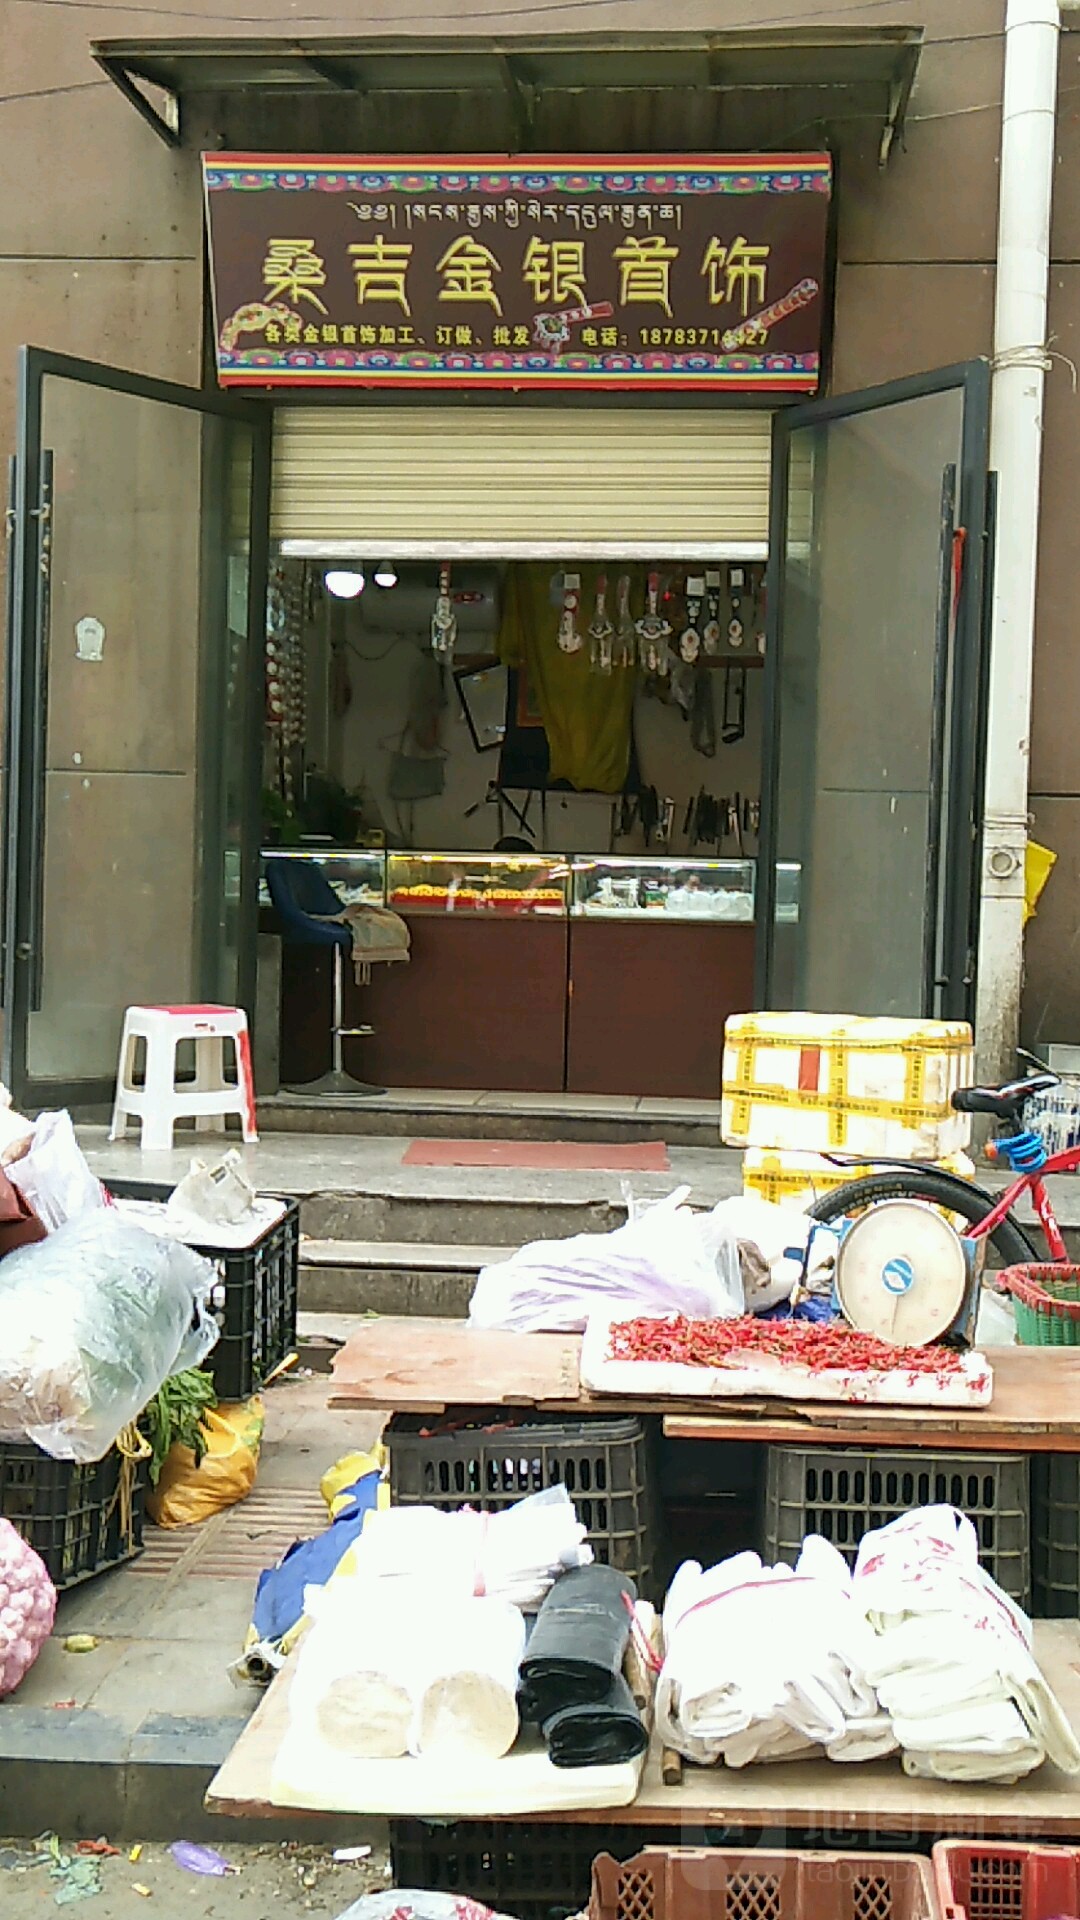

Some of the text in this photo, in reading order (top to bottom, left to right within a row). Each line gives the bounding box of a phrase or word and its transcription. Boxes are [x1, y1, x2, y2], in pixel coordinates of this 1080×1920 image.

[263, 234, 770, 318] 桑吉金银首饰
